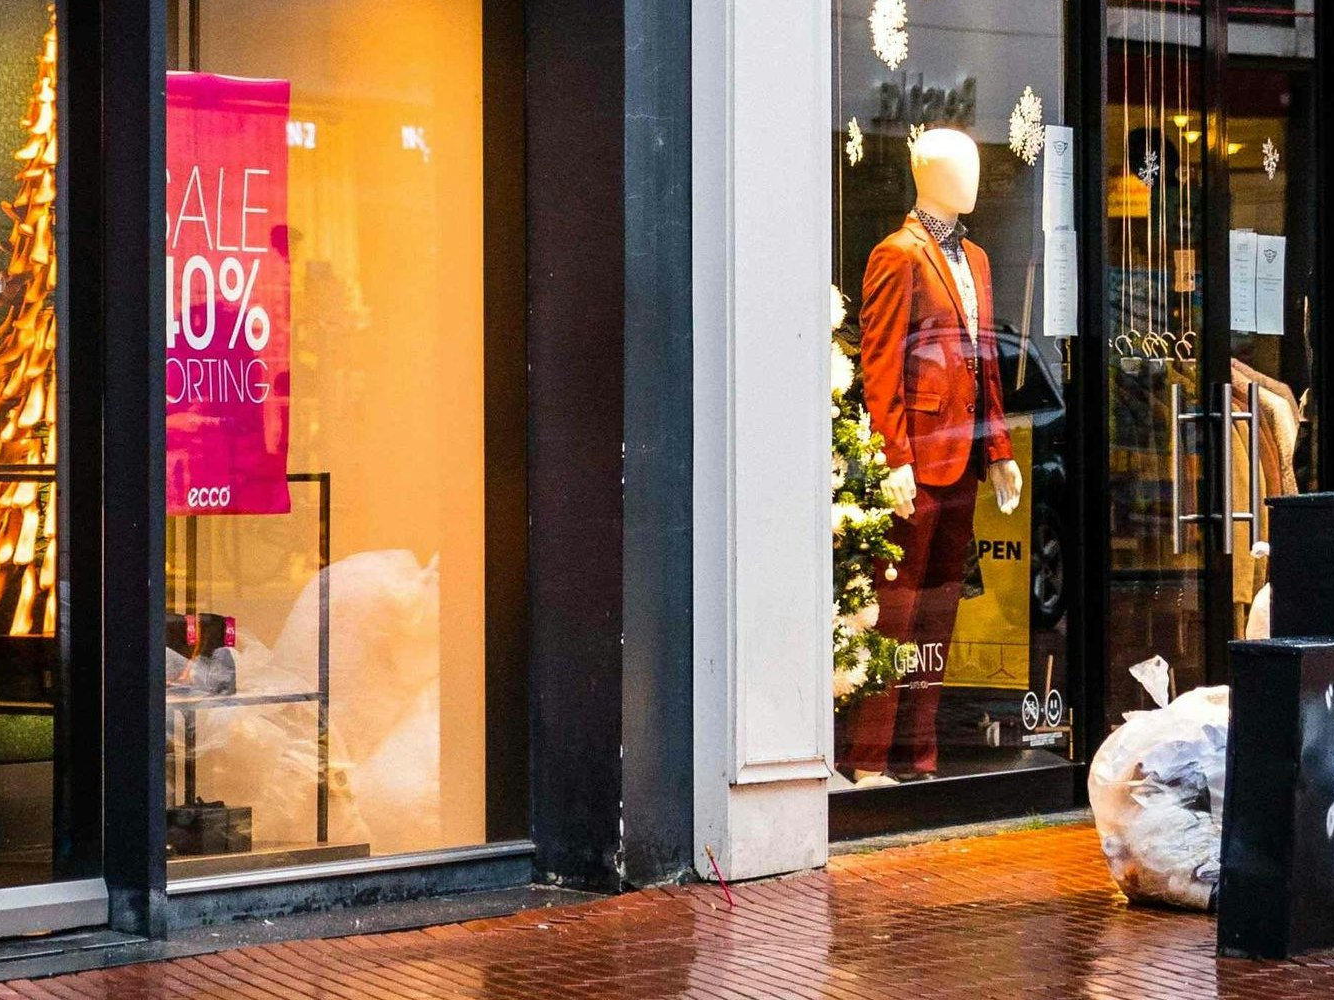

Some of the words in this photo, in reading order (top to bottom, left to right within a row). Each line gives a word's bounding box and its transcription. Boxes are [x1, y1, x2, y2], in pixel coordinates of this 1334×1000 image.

[166, 166, 270, 252] ALE
[188, 487, 230, 507] ecco
[894, 642, 944, 675] GENTS
